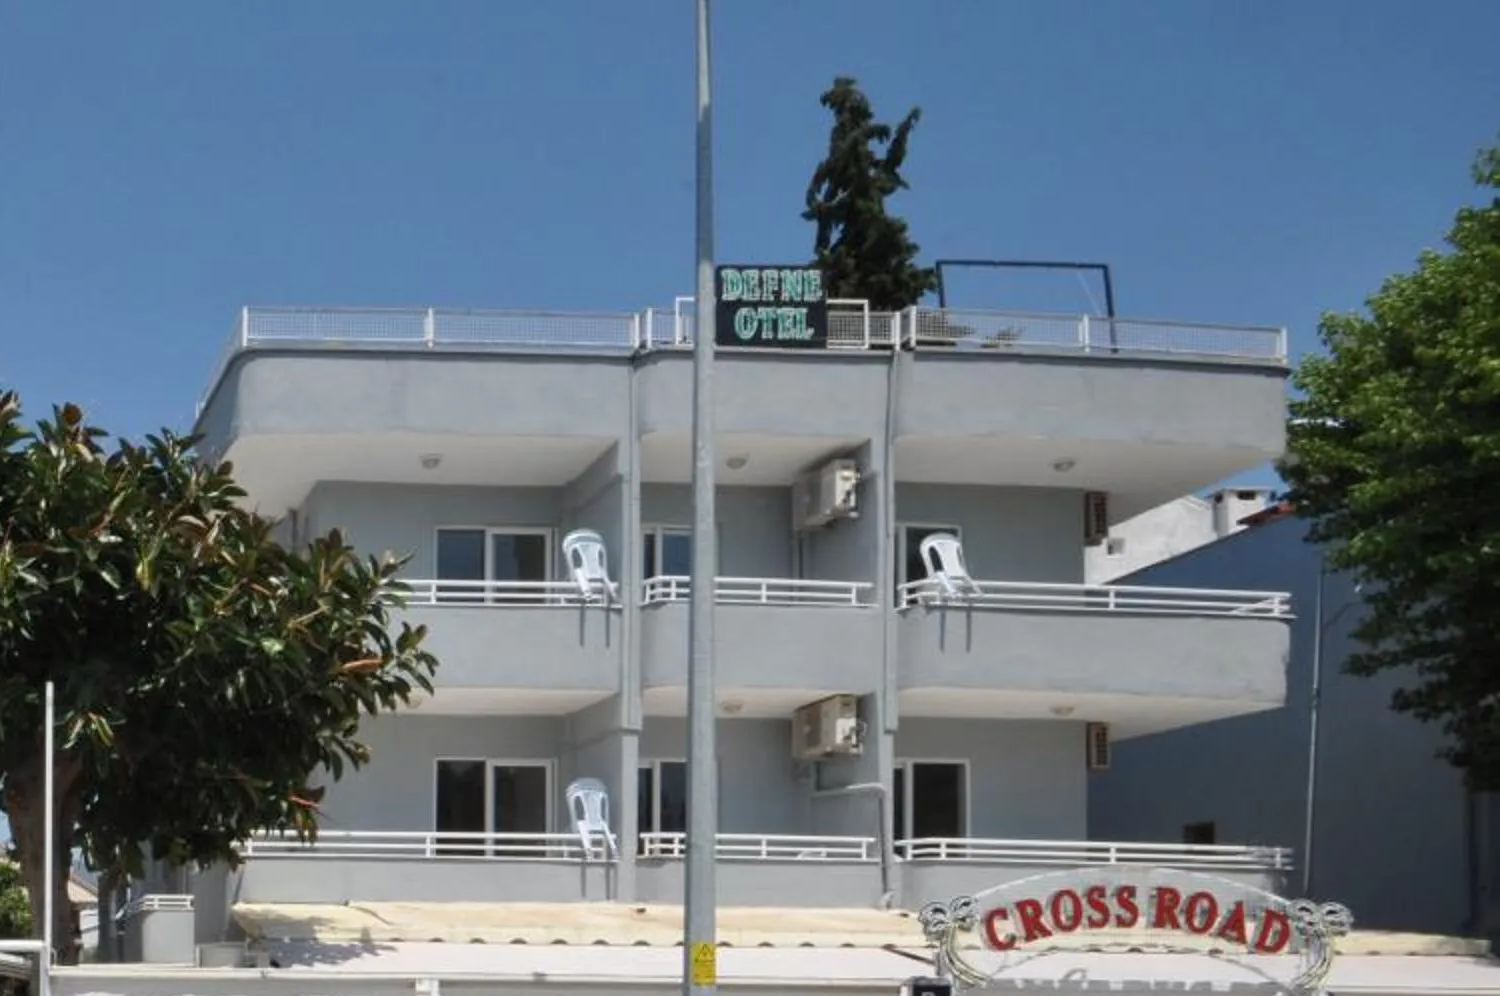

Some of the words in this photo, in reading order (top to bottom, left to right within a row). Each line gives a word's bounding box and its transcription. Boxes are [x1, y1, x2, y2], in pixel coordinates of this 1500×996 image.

[721, 267, 822, 302] DEFNE
[734, 307, 815, 340] OTEL
[984, 885, 1140, 951] CROSS
[1151, 886, 1292, 954] ROAD
